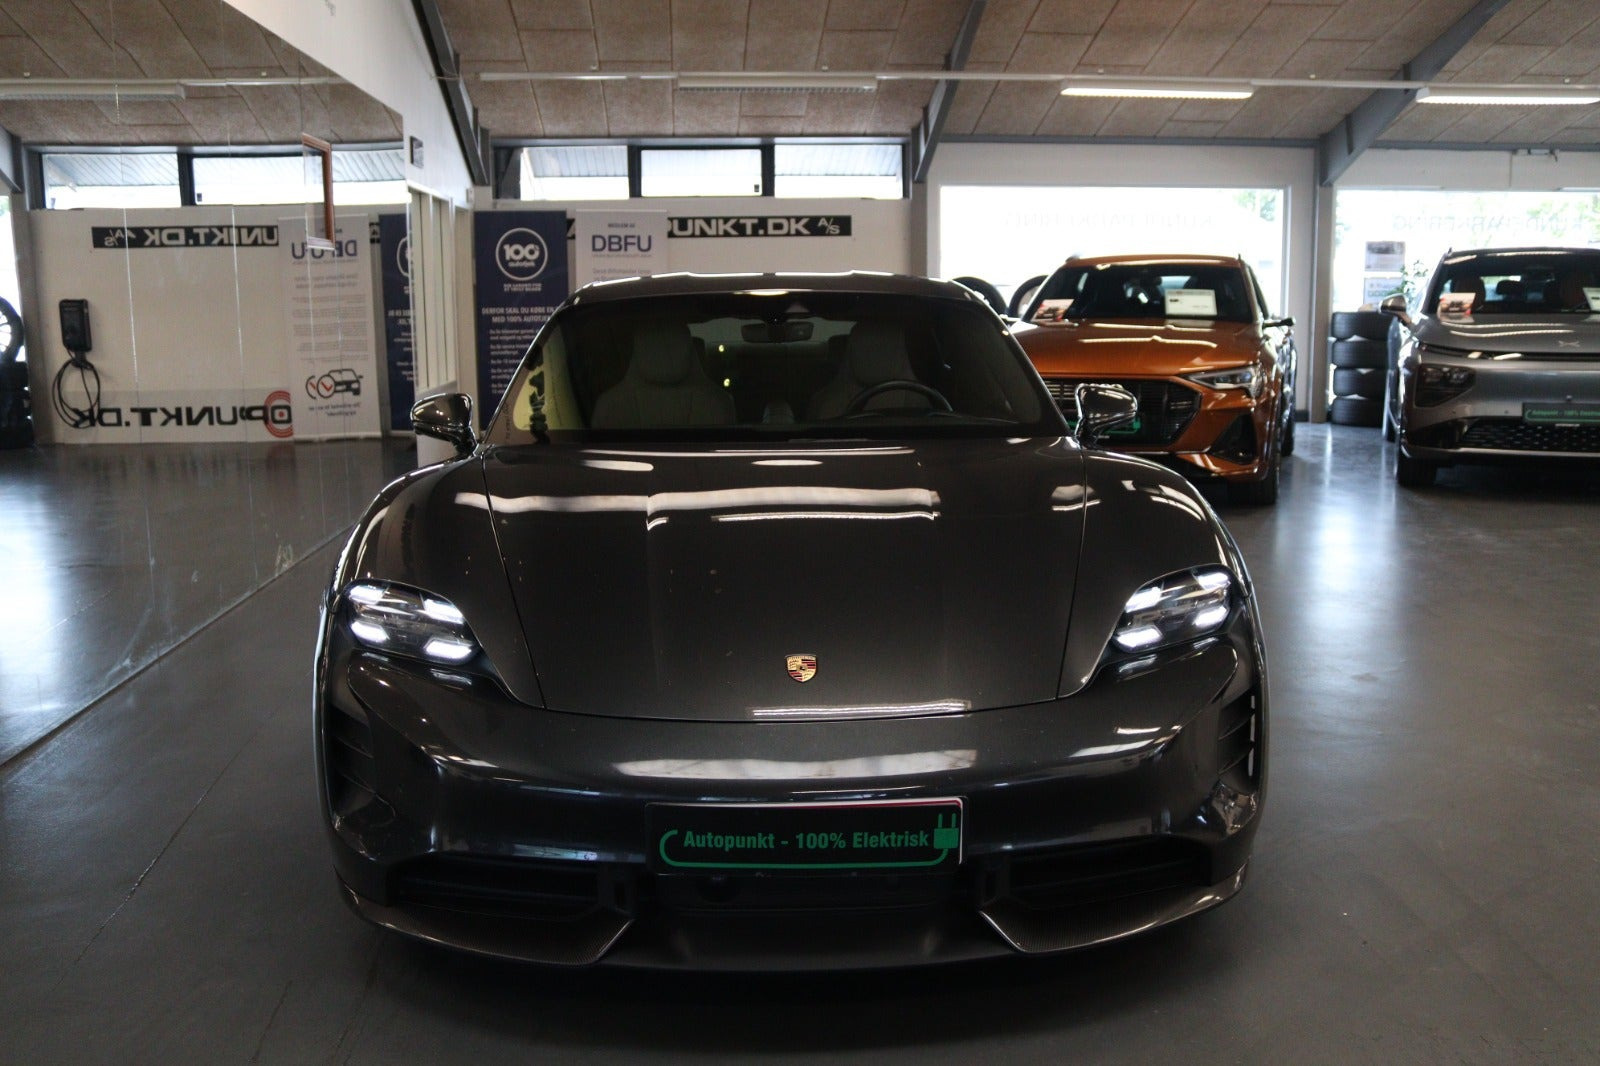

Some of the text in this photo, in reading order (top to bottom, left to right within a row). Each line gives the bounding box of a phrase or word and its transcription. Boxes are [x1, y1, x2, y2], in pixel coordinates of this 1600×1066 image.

[817, 217, 840, 235] A/S
[592, 235, 652, 252] DBFU
[683, 830, 775, 852] Autopunkt
[796, 832, 846, 849] 100%
[852, 830, 928, 849] Elektrisk
